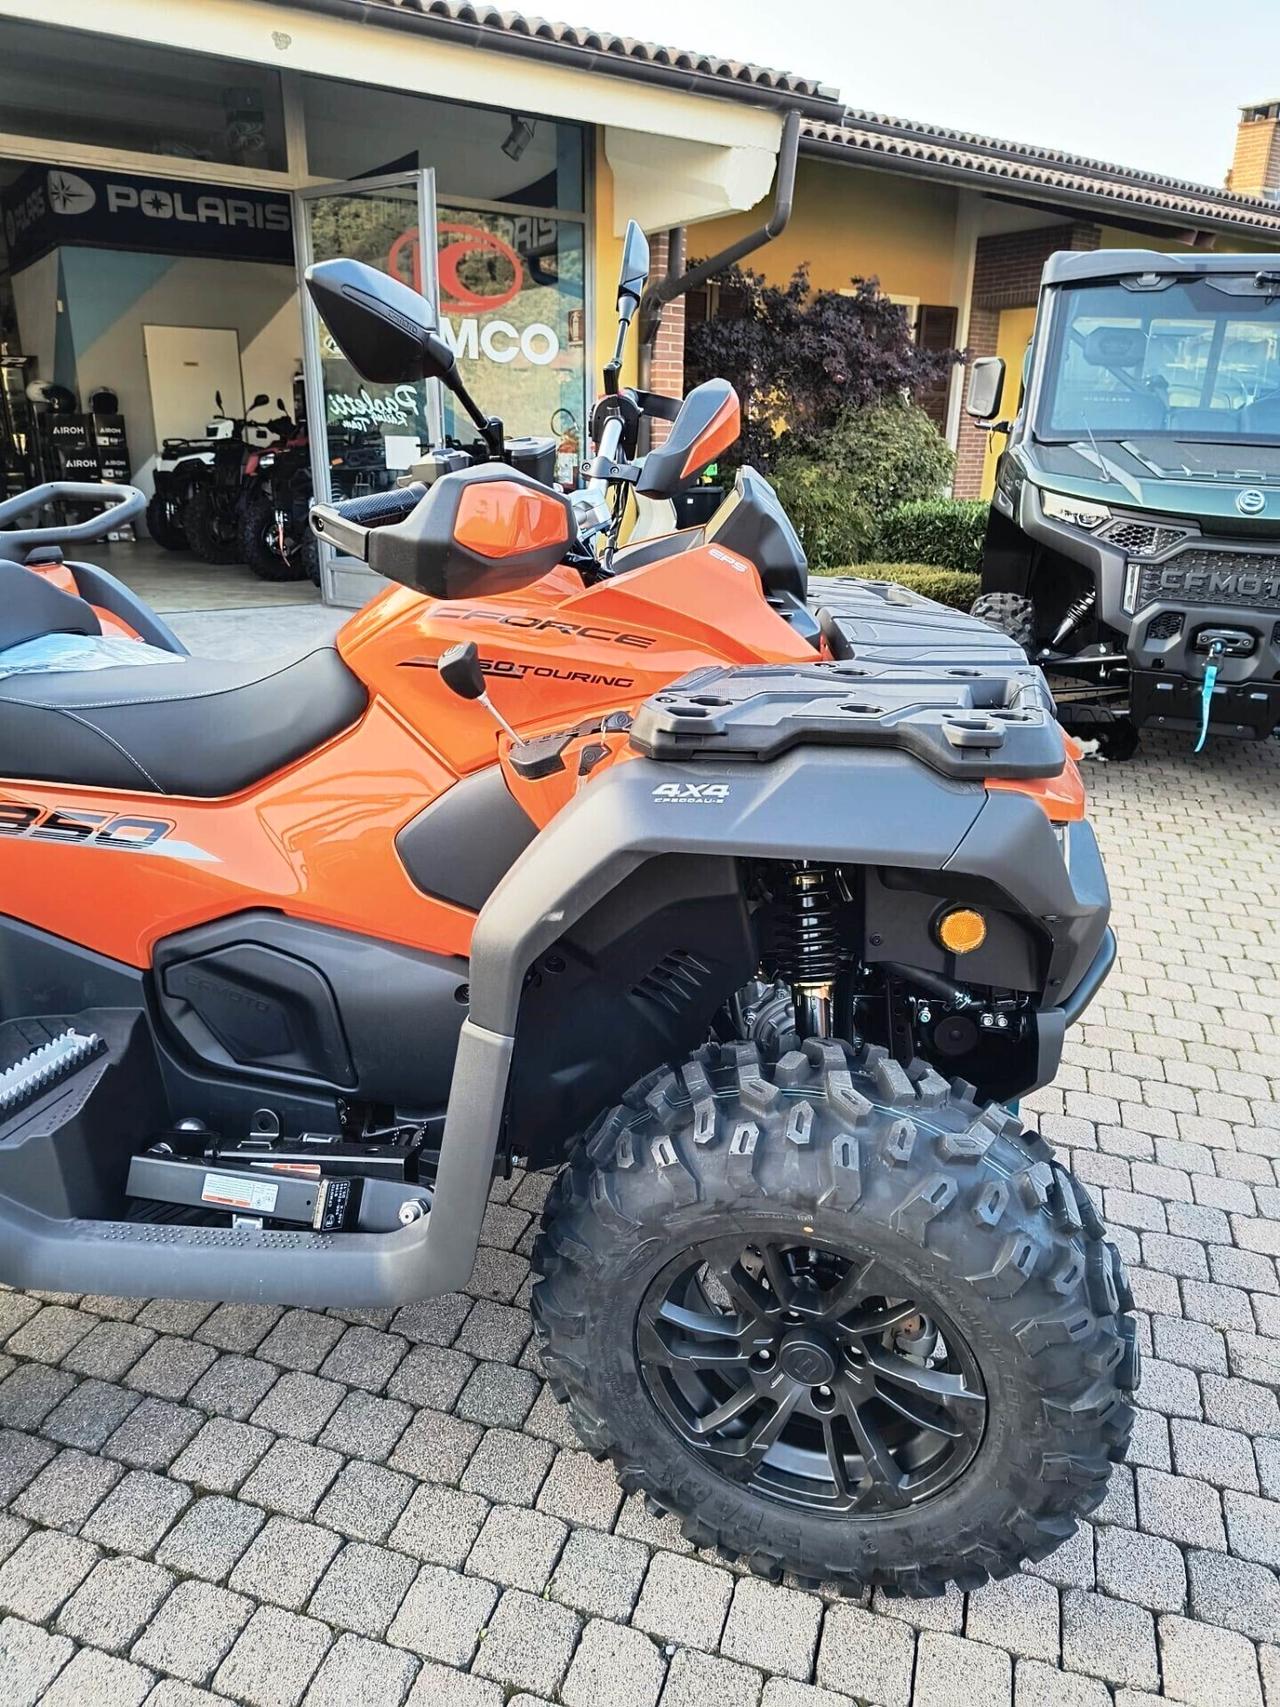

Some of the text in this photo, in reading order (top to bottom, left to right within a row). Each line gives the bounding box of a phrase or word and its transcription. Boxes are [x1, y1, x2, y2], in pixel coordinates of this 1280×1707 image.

[106, 184, 291, 232] POLARIS
[438, 316, 560, 365] MCO
[53, 426, 85, 435] AIROH
[66, 459, 97, 468] AIROH
[708, 547, 748, 573] EPS
[426, 606, 658, 650] CFORCE
[477, 657, 635, 689] 50 TOURING
